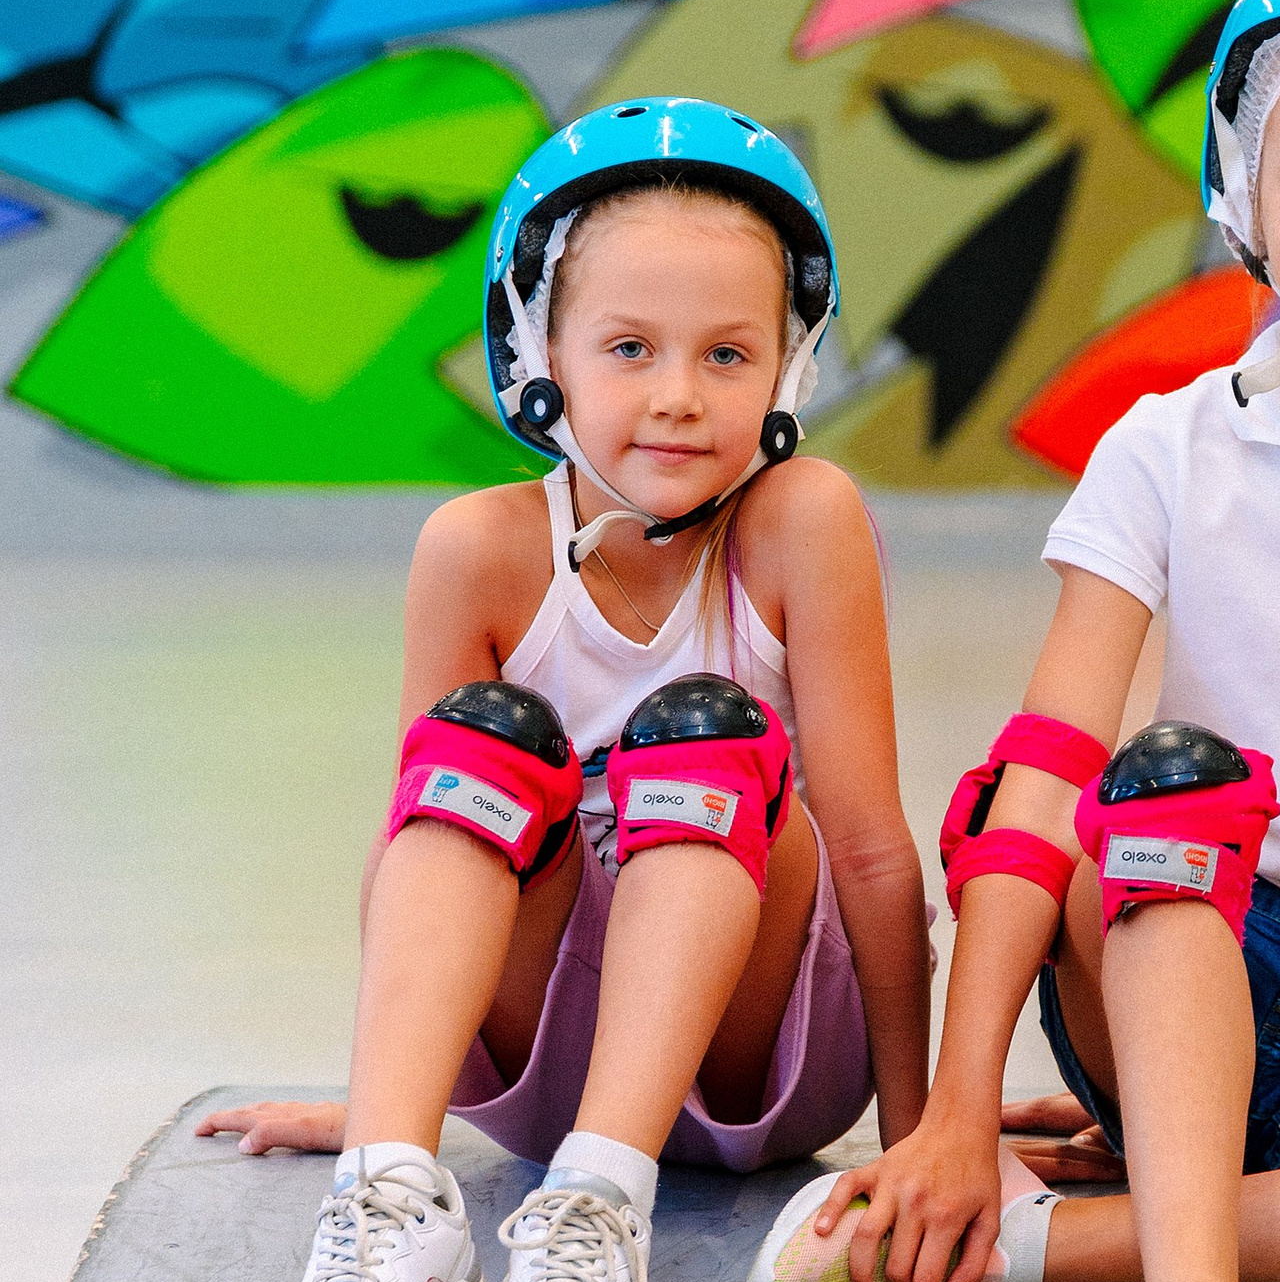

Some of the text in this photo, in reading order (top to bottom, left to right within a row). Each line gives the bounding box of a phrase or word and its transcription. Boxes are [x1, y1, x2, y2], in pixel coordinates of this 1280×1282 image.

[643, 794, 684, 806] oxelo
[472, 795, 512, 822] oxelo
[1122, 851, 1167, 864] oxelo
